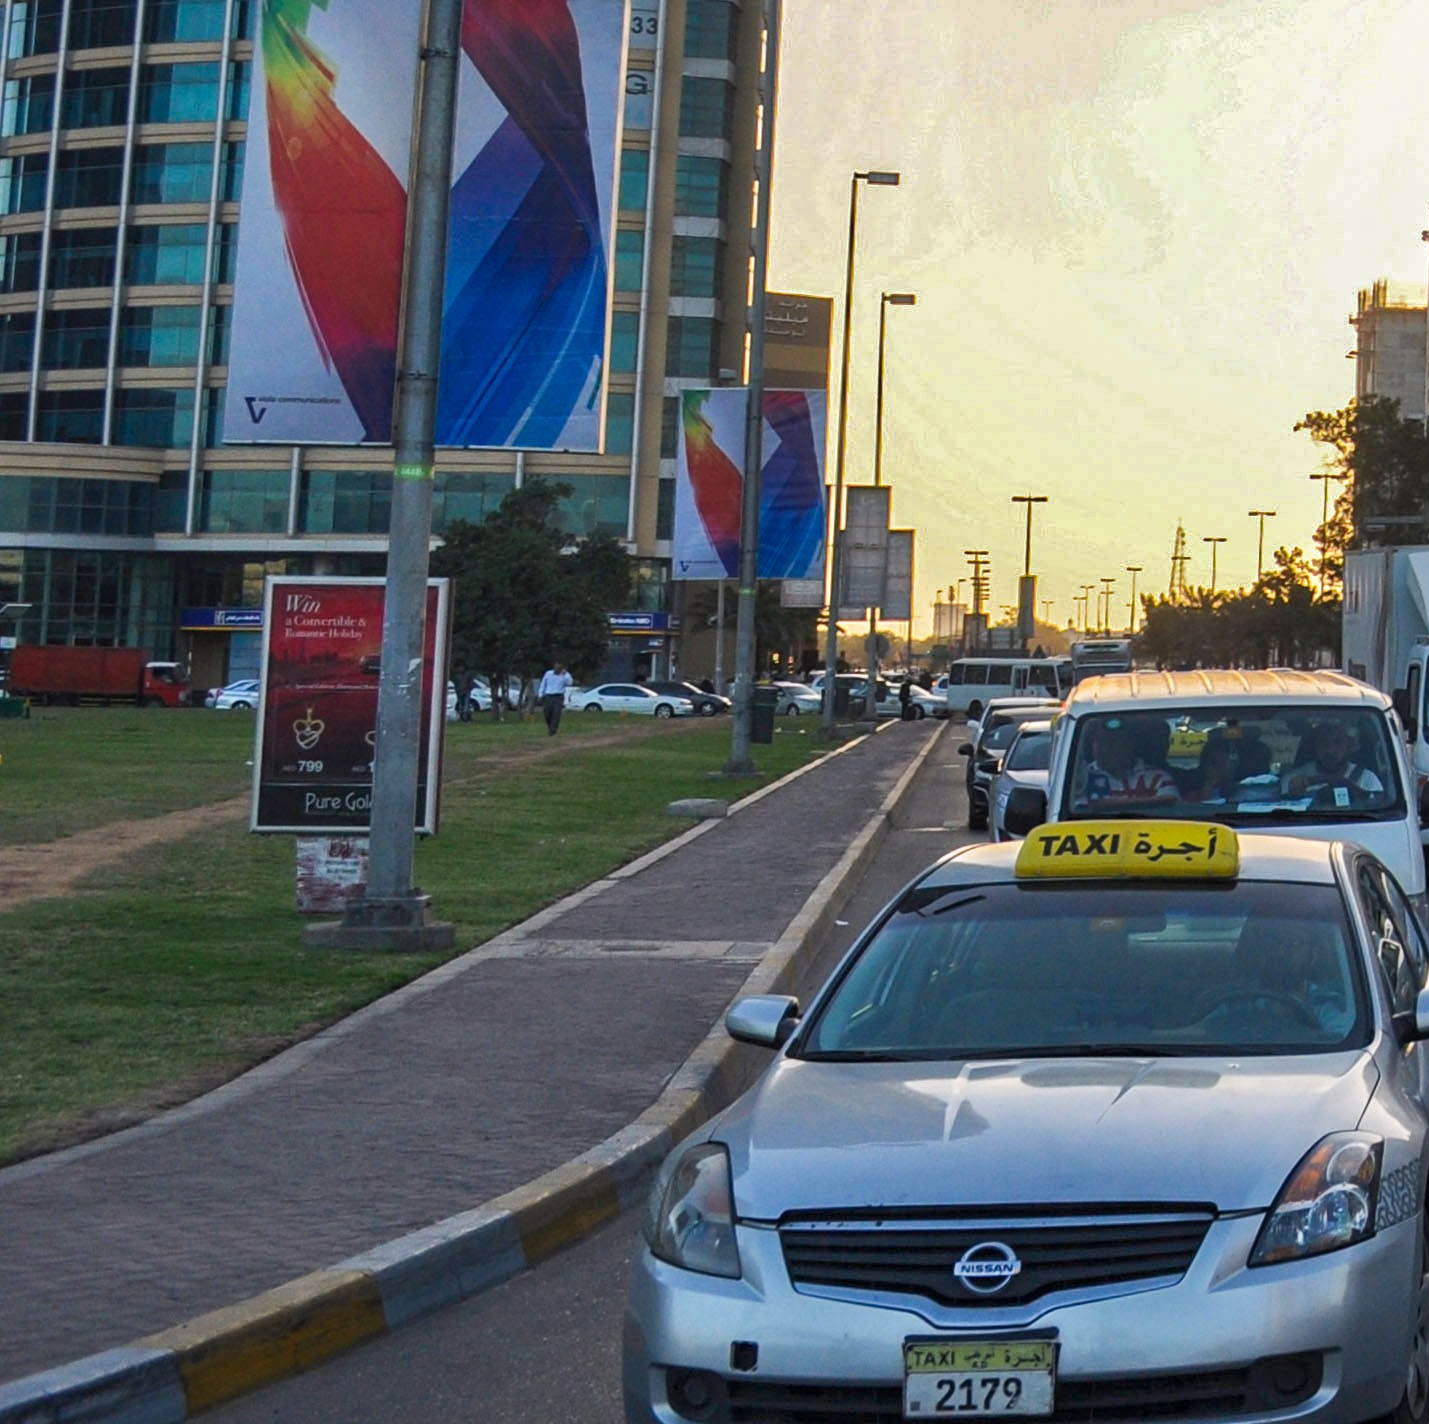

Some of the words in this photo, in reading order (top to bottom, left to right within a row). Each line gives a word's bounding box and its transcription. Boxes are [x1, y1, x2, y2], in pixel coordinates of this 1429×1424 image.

[286, 594, 321, 613] Win
[294, 615, 356, 627] Convertible
[360, 617, 367, 627] &
[285, 627, 326, 639] Romantic
[329, 628, 363, 641] Holiday
[298, 760, 324, 773] 799
[305, 792, 341, 814] Pure
[1039, 834, 1120, 856] TAXI
[1133, 827, 1217, 861] أجرة
[961, 1263, 1013, 1273] NISSAN
[914, 1351, 955, 1367] TAXI
[936, 1377, 1022, 1412] 2179
